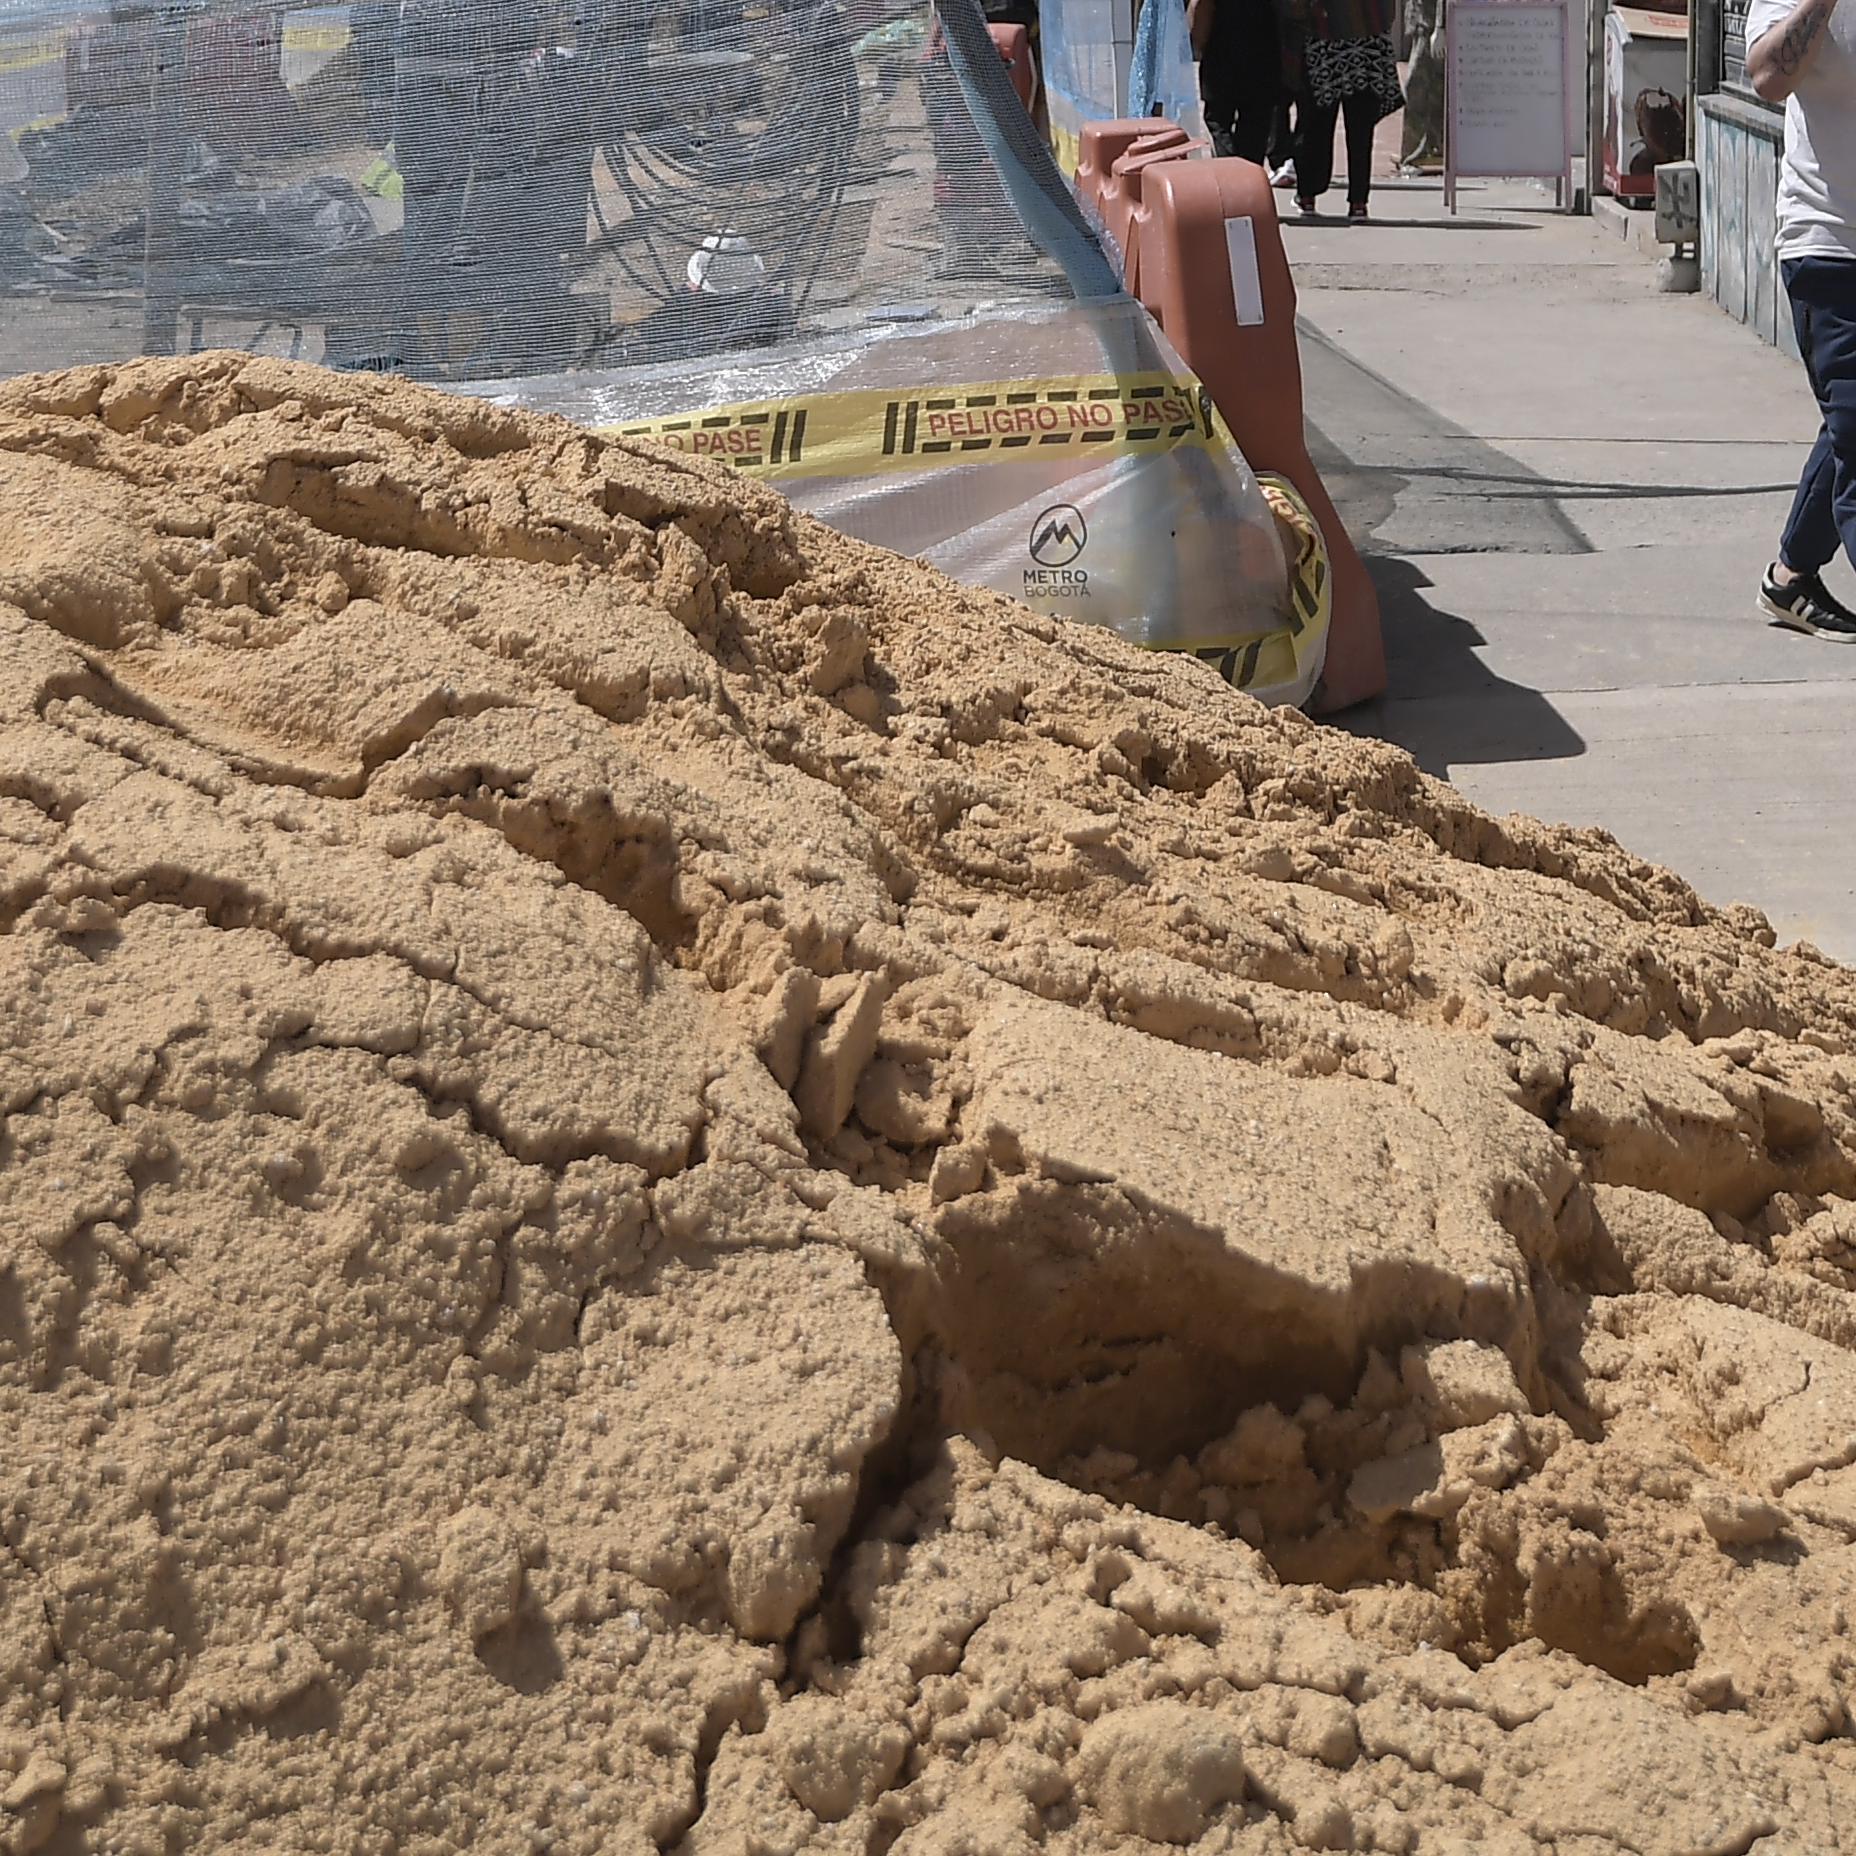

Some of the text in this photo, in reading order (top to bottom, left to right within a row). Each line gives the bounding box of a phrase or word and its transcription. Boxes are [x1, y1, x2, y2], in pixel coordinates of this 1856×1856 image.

[928, 405, 1059, 438] PELIGRO
[1069, 402, 1114, 429] NO
[693, 428, 762, 455] PASE
[1023, 569, 1088, 584] METRO
[1024, 583, 1091, 598] BOGOTÁ
